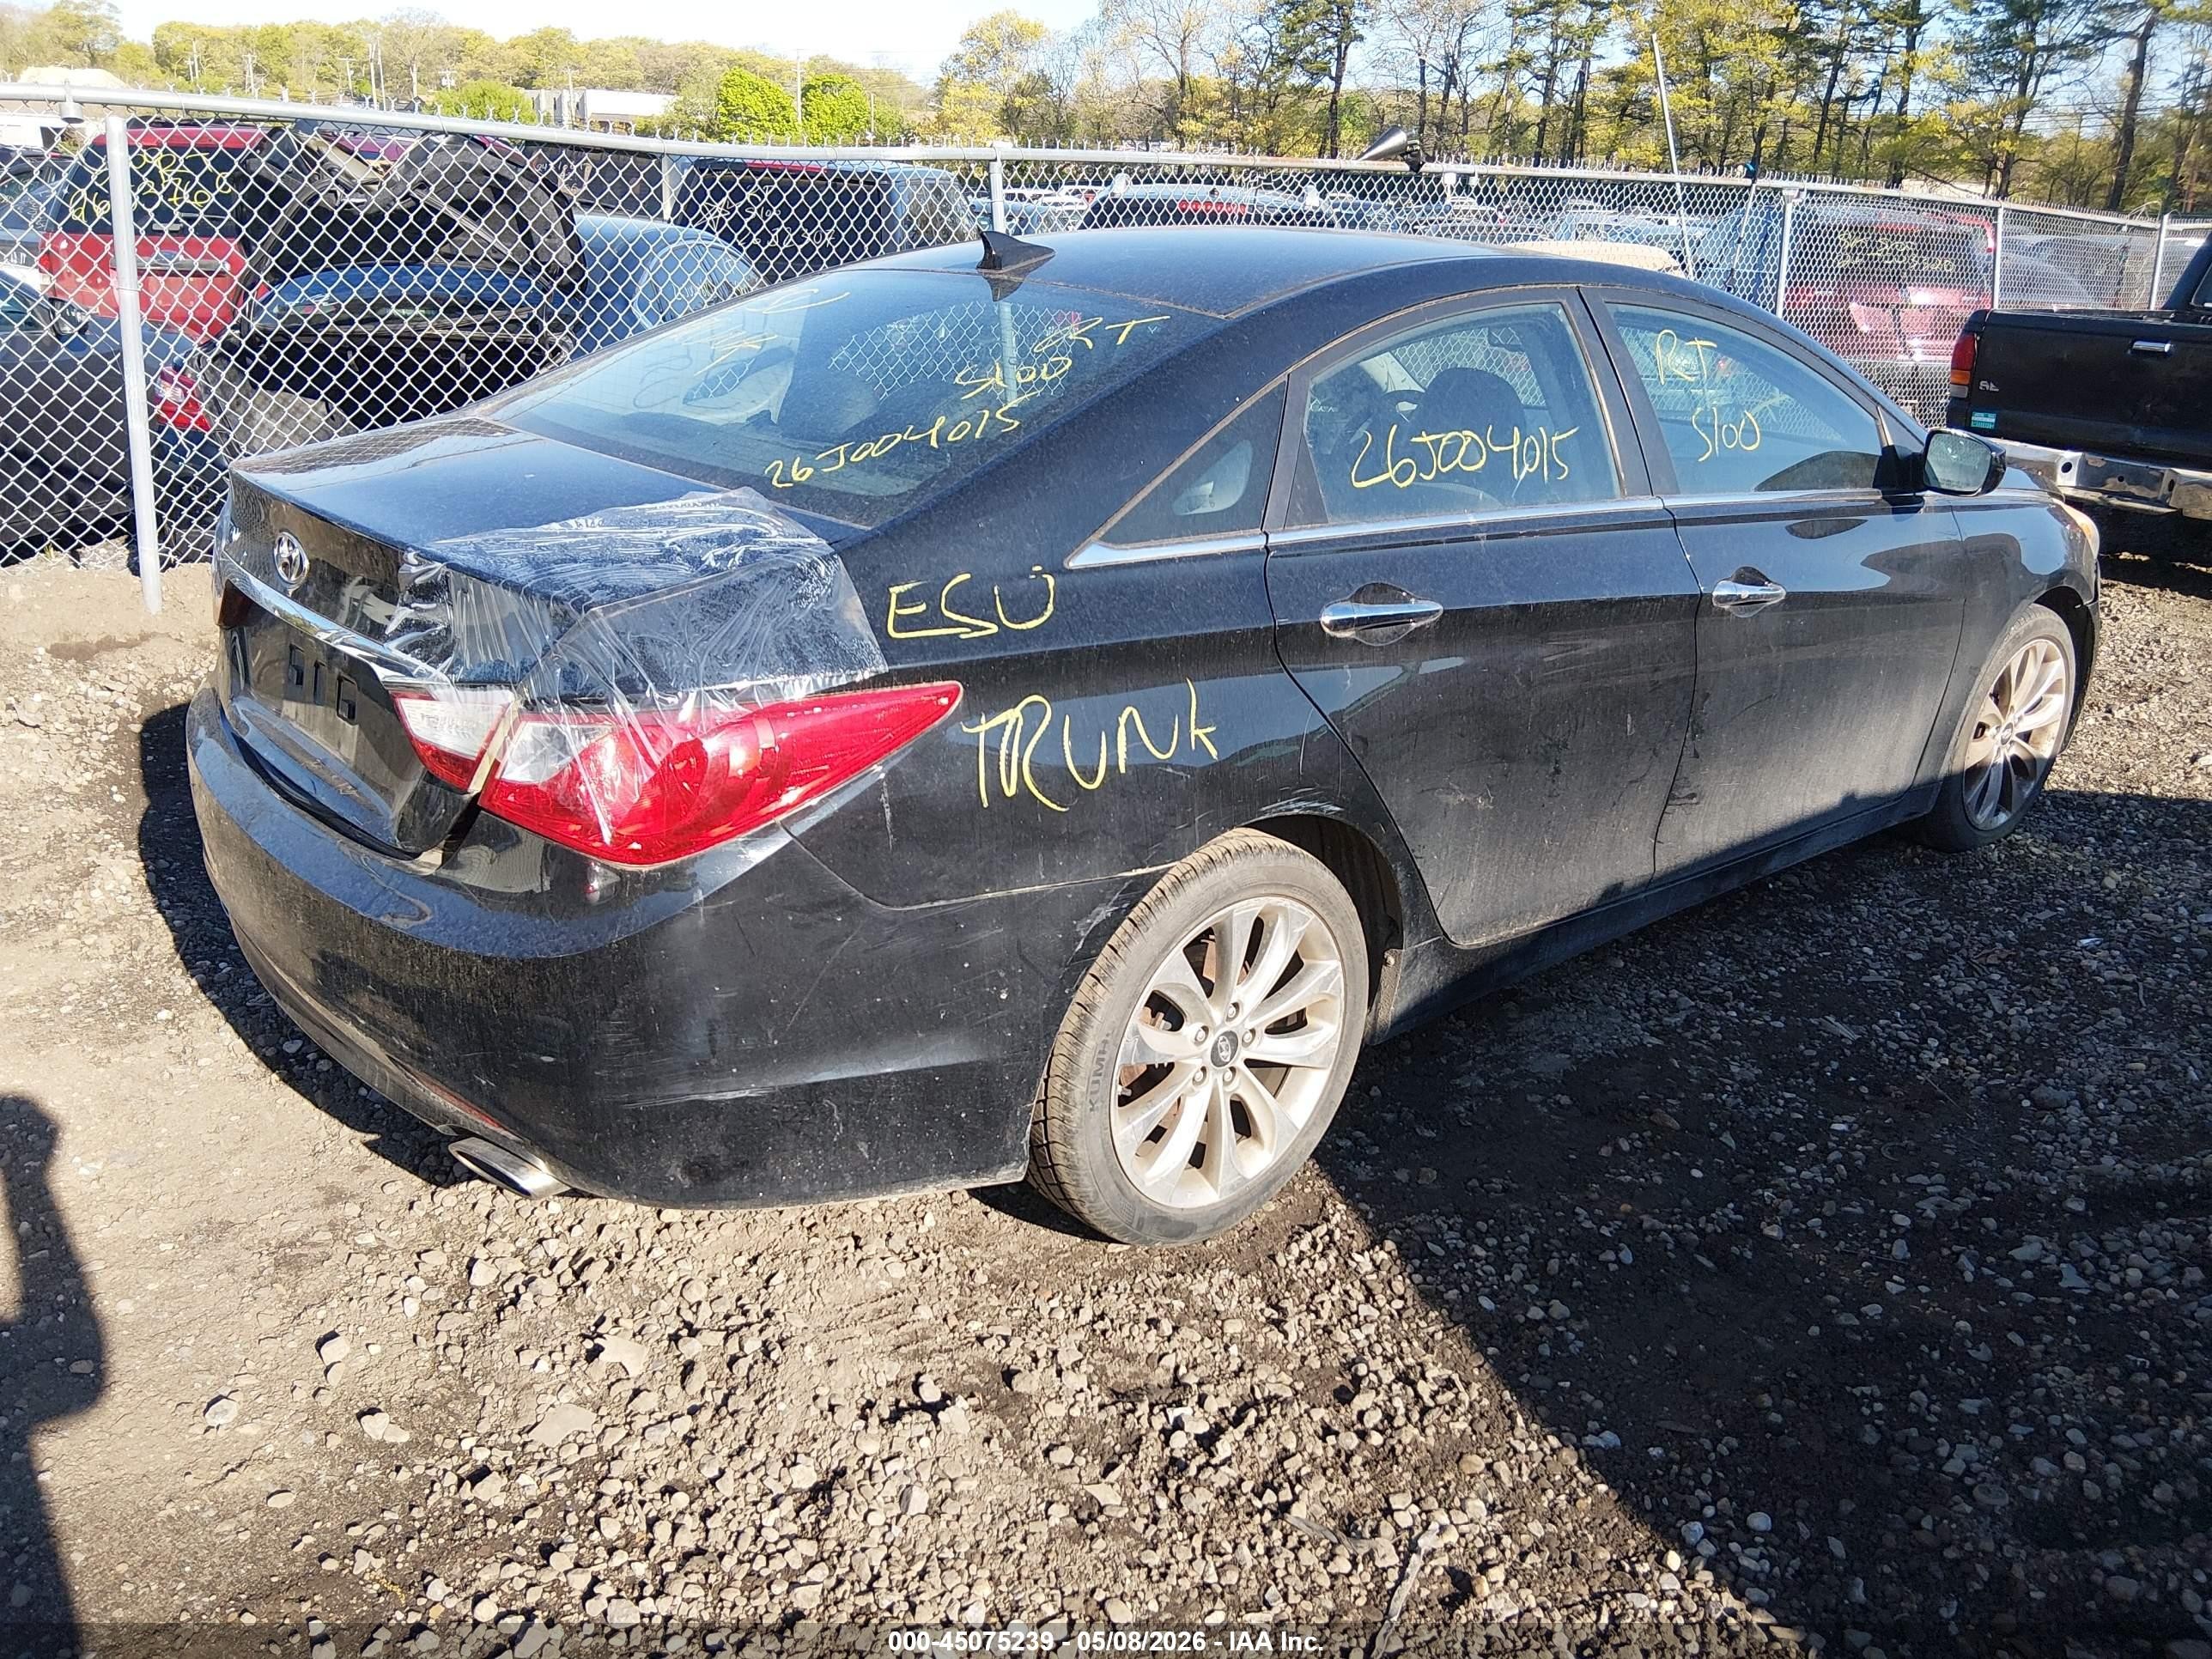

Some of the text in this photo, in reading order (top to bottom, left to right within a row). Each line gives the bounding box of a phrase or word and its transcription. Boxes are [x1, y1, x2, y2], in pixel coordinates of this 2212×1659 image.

[1656, 329, 1717, 385] RT
[763, 390, 1040, 488] 26J004015
[1351, 424, 1579, 489] 26J004015
[1690, 406, 1761, 462] S100
